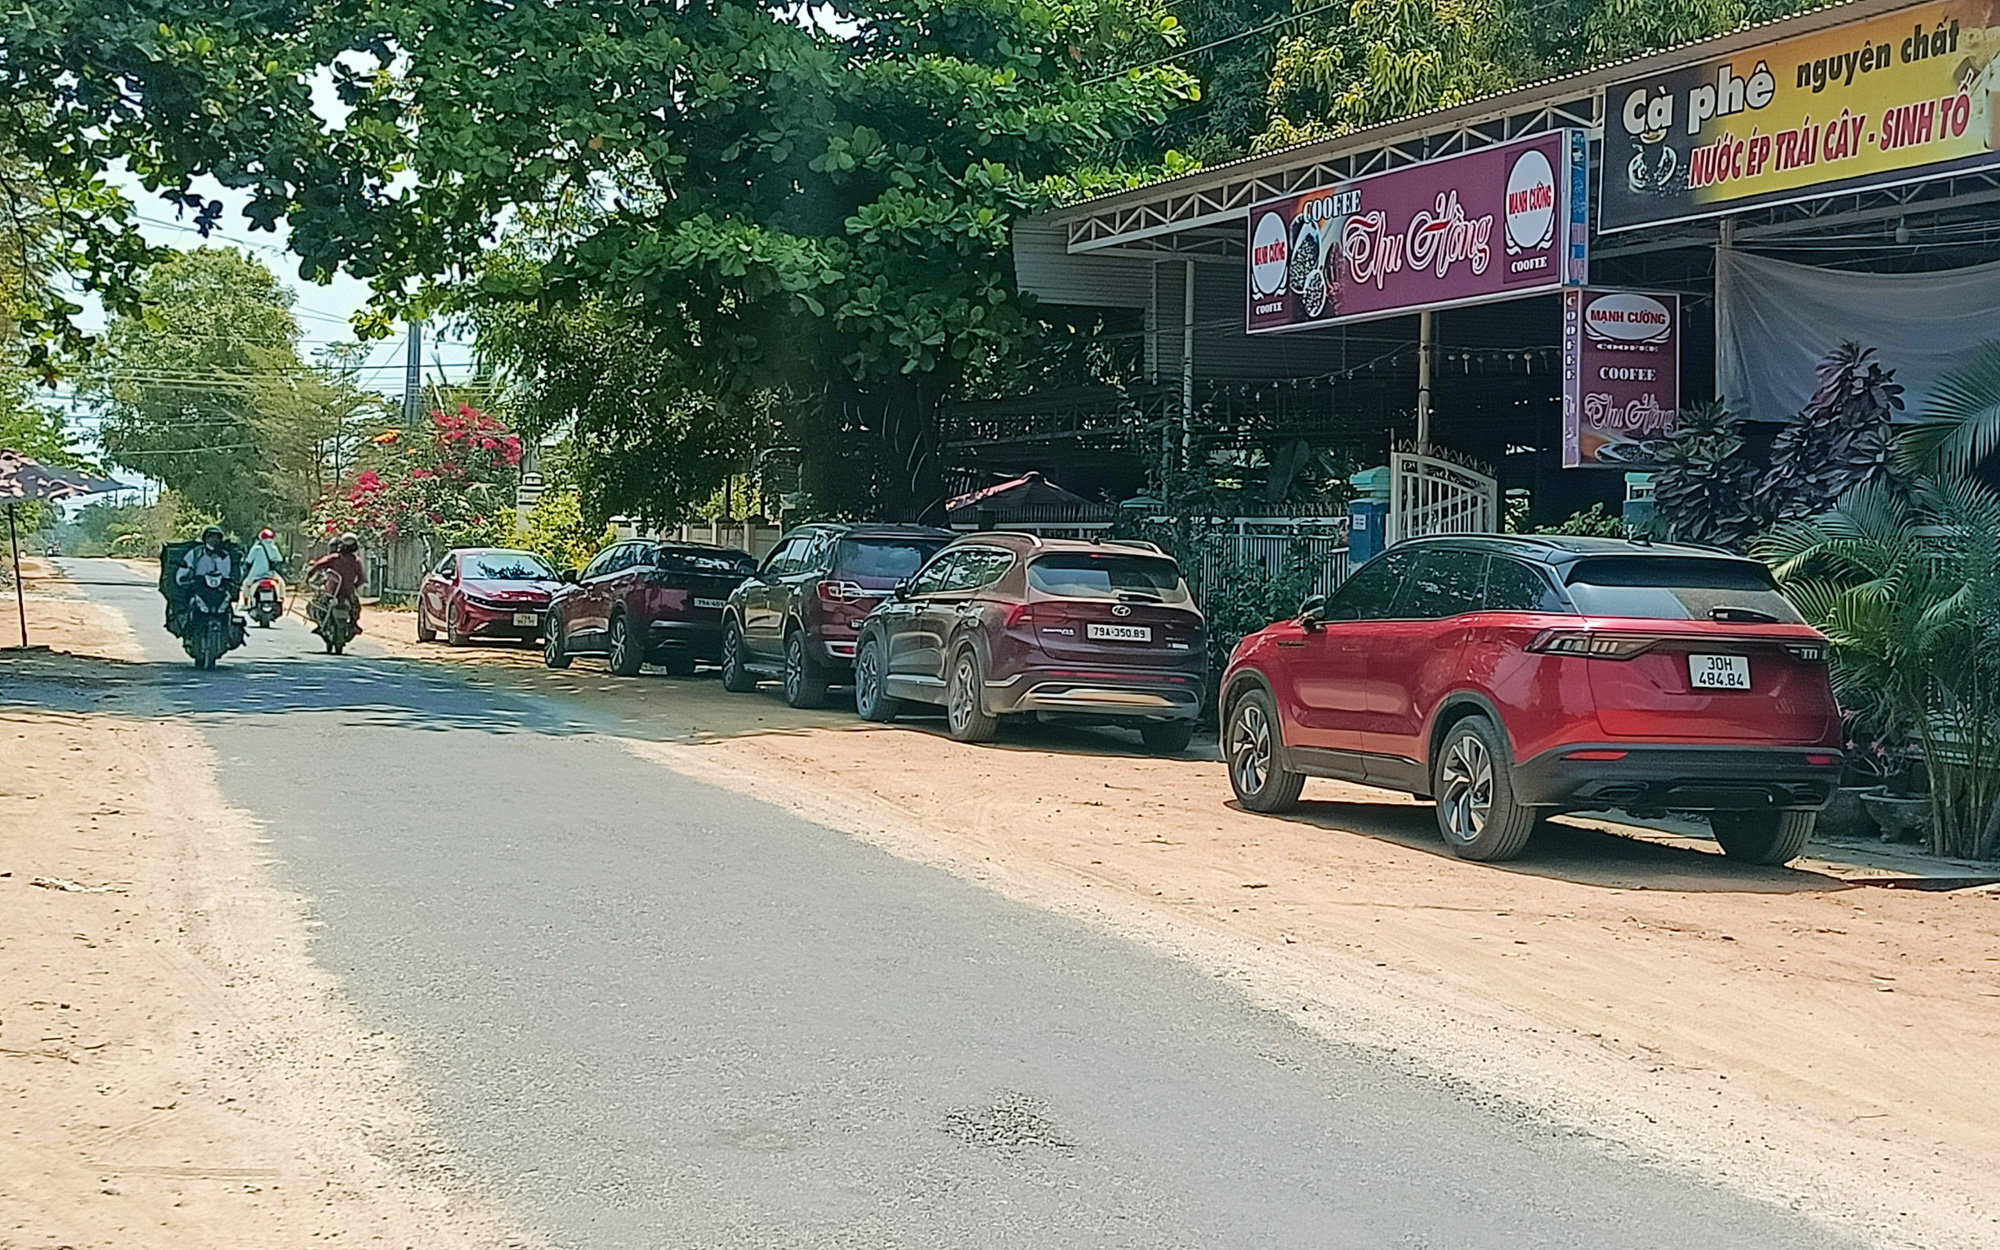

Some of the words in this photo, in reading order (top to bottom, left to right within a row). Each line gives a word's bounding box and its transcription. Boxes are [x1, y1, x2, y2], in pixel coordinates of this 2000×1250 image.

[1796, 41, 1891, 93] nguyên
[1900, 17, 1960, 65] chất
[1623, 86, 1674, 136] Cà
[1687, 59, 1776, 136] phê
[1688, 131, 1744, 191] NƯỚC
[1745, 127, 1772, 177] ÉP
[1774, 116, 1819, 172] TRÁI
[1822, 107, 1866, 163] CÂY
[1881, 99, 1936, 151] SINH
[1939, 67, 1975, 139] TỐ
[1303, 188, 1362, 224] COOFEE
[1508, 190, 1528, 219] MẠNH
[1511, 256, 1548, 273] COOFEE
[1590, 309, 1624, 325] MẠNH
[1627, 308, 1666, 326] CƯỜNG
[1599, 366, 1656, 382] COOFEE
[1706, 657, 1733, 671] 30H
[1698, 672, 1744, 687] 484.84
